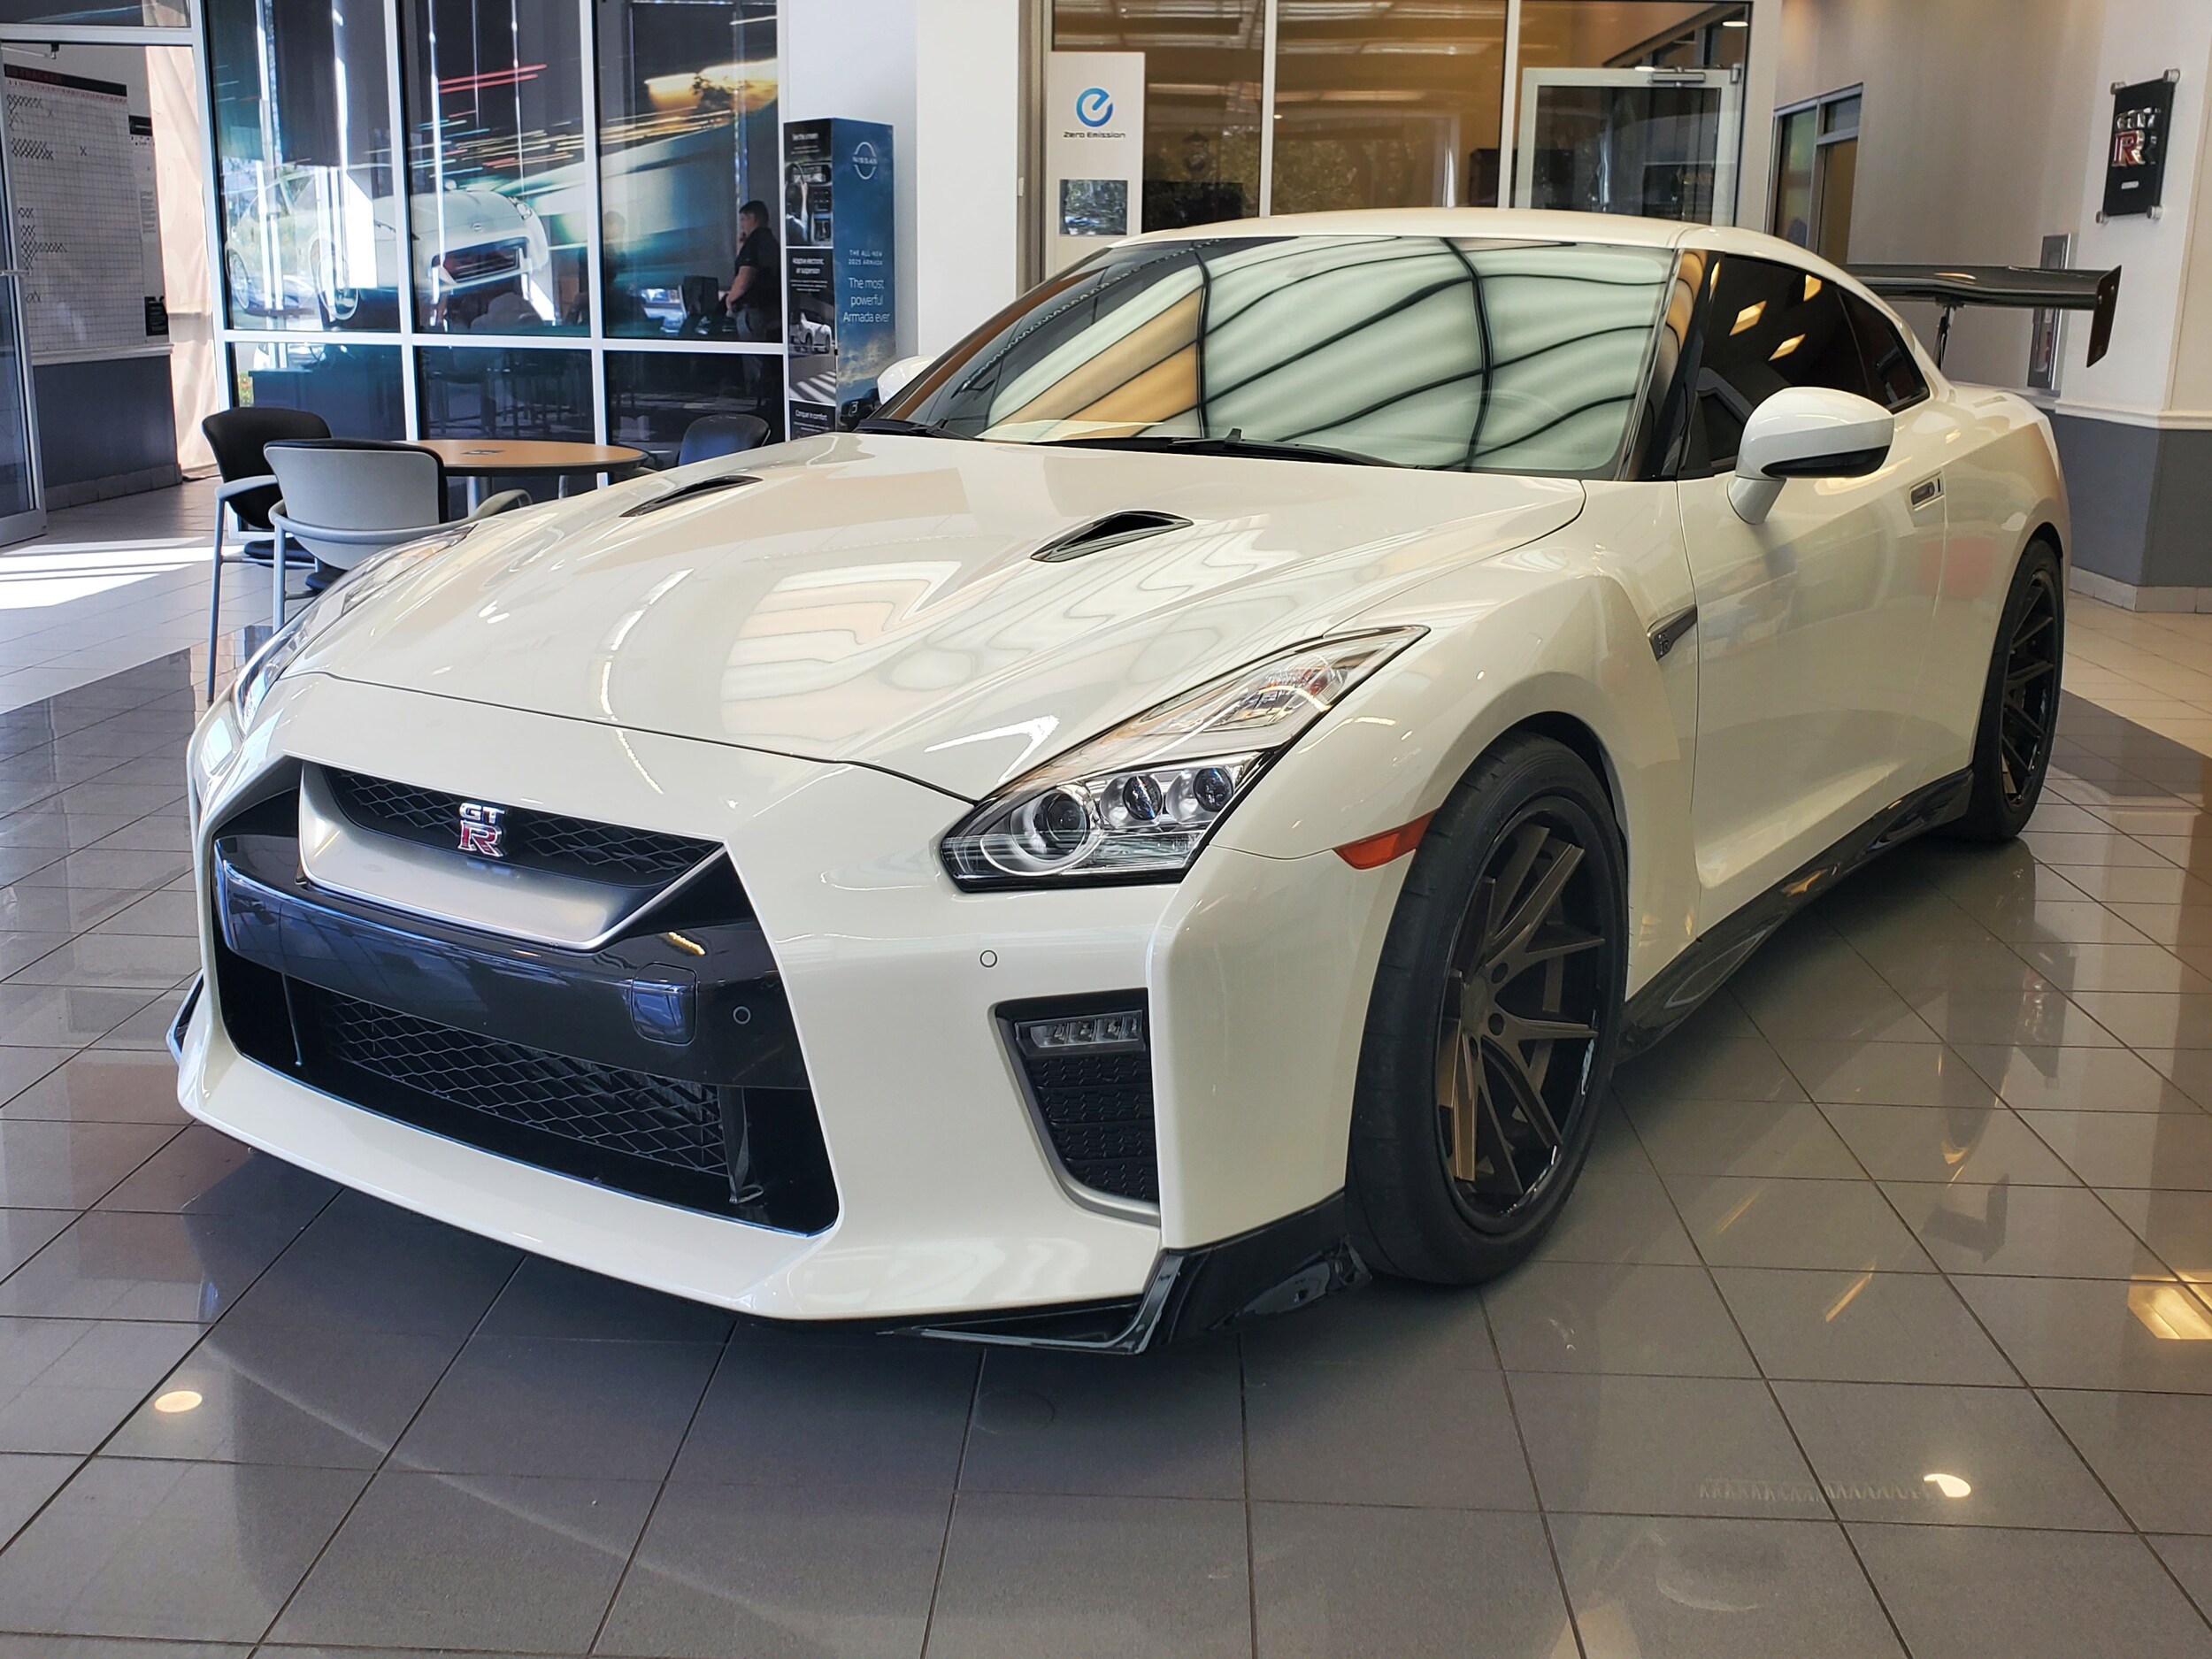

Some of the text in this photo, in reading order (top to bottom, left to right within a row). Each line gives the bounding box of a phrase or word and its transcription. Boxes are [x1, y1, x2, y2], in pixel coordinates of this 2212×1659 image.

[2111, 129, 2147, 167] R
[852, 156, 878, 165] NISSAN
[849, 277, 884, 289] The most
[850, 294, 884, 308] powerful
[843, 311, 890, 323] Armada ever
[459, 802, 505, 824] GT
[457, 819, 504, 857] R
